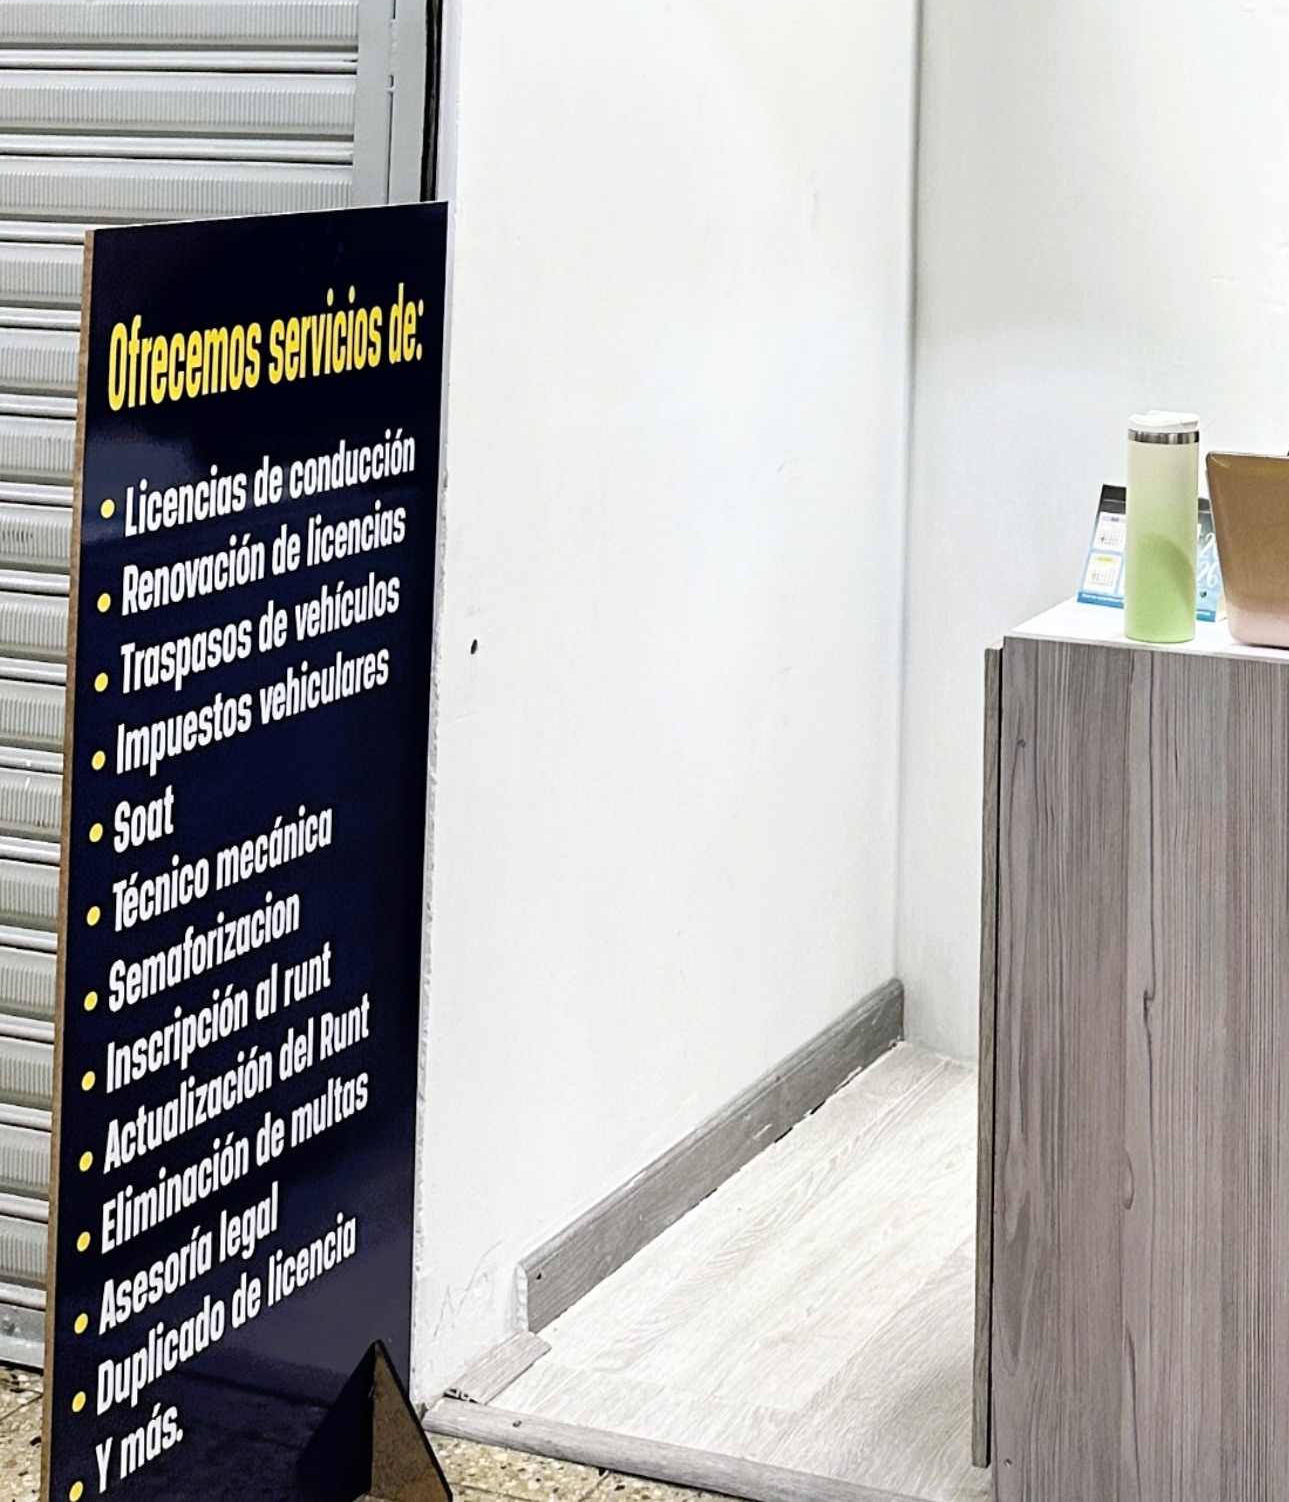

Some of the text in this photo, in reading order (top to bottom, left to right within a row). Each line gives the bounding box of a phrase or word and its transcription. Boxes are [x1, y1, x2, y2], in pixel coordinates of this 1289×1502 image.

[107, 283, 425, 412] Ofrecemos servicios de:
[124, 428, 416, 537] Licencias de conducción
[121, 499, 407, 616] Renovación de licencias
[120, 571, 401, 694] Traspasos de vehículos
[116, 648, 390, 777] Impuestos vehiculares
[112, 804, 333, 932] Técnico mecánica
[113, 784, 175, 853] Soat
[108, 892, 300, 1013] Semaforizacion
[106, 941, 332, 1094] Inscripción al runt
[103, 992, 370, 1175] Actualización del Runt
[101, 1072, 369, 1254] Eliminación de multas
[96, 1212, 356, 1416] Duplicado de licencia
[98, 1180, 279, 1336] Asesoría legal
[96, 1401, 184, 1494] Y más.
